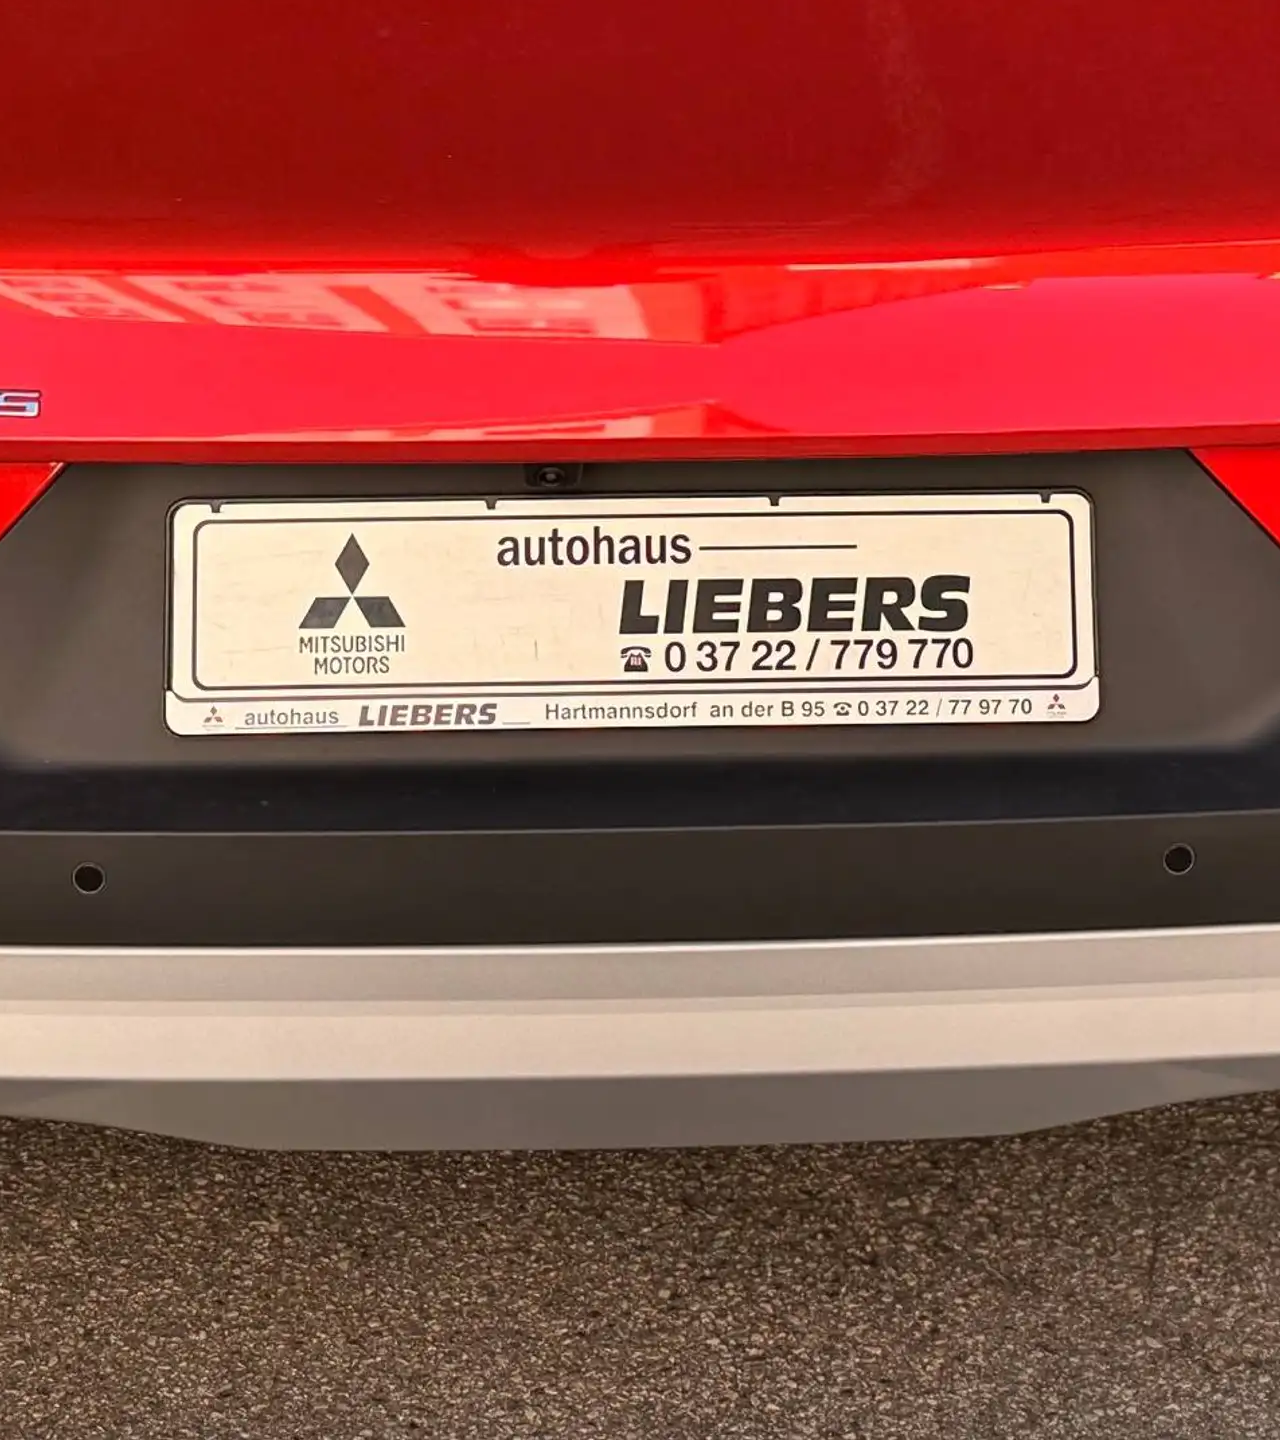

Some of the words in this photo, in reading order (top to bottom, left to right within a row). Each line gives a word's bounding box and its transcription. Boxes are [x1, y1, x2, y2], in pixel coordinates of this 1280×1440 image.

[496, 525, 693, 567] autohaus
[618, 574, 971, 635] LIEBERS
[299, 634, 405, 654] MITSUBISHI
[664, 641, 687, 673] 0
[696, 640, 741, 672] 37
[751, 639, 797, 671] 22
[805, 638, 821, 672] /
[830, 638, 898, 670] 779
[907, 637, 974, 669] 770
[314, 655, 390, 675] MOTORS
[244, 708, 339, 726] autohaus
[358, 702, 498, 727] LIEBERS
[545, 701, 698, 721] Hartmannsdorf
[709, 704, 734, 718] an
[740, 700, 774, 718] der
[781, 700, 795, 718] B
[801, 700, 826, 718] 95
[857, 699, 870, 717] 0
[875, 699, 900, 717] 37
[905, 699, 929, 716] 22
[948, 698, 972, 716] 77
[978, 698, 1002, 716] 97
[1008, 697, 1033, 715] 70
